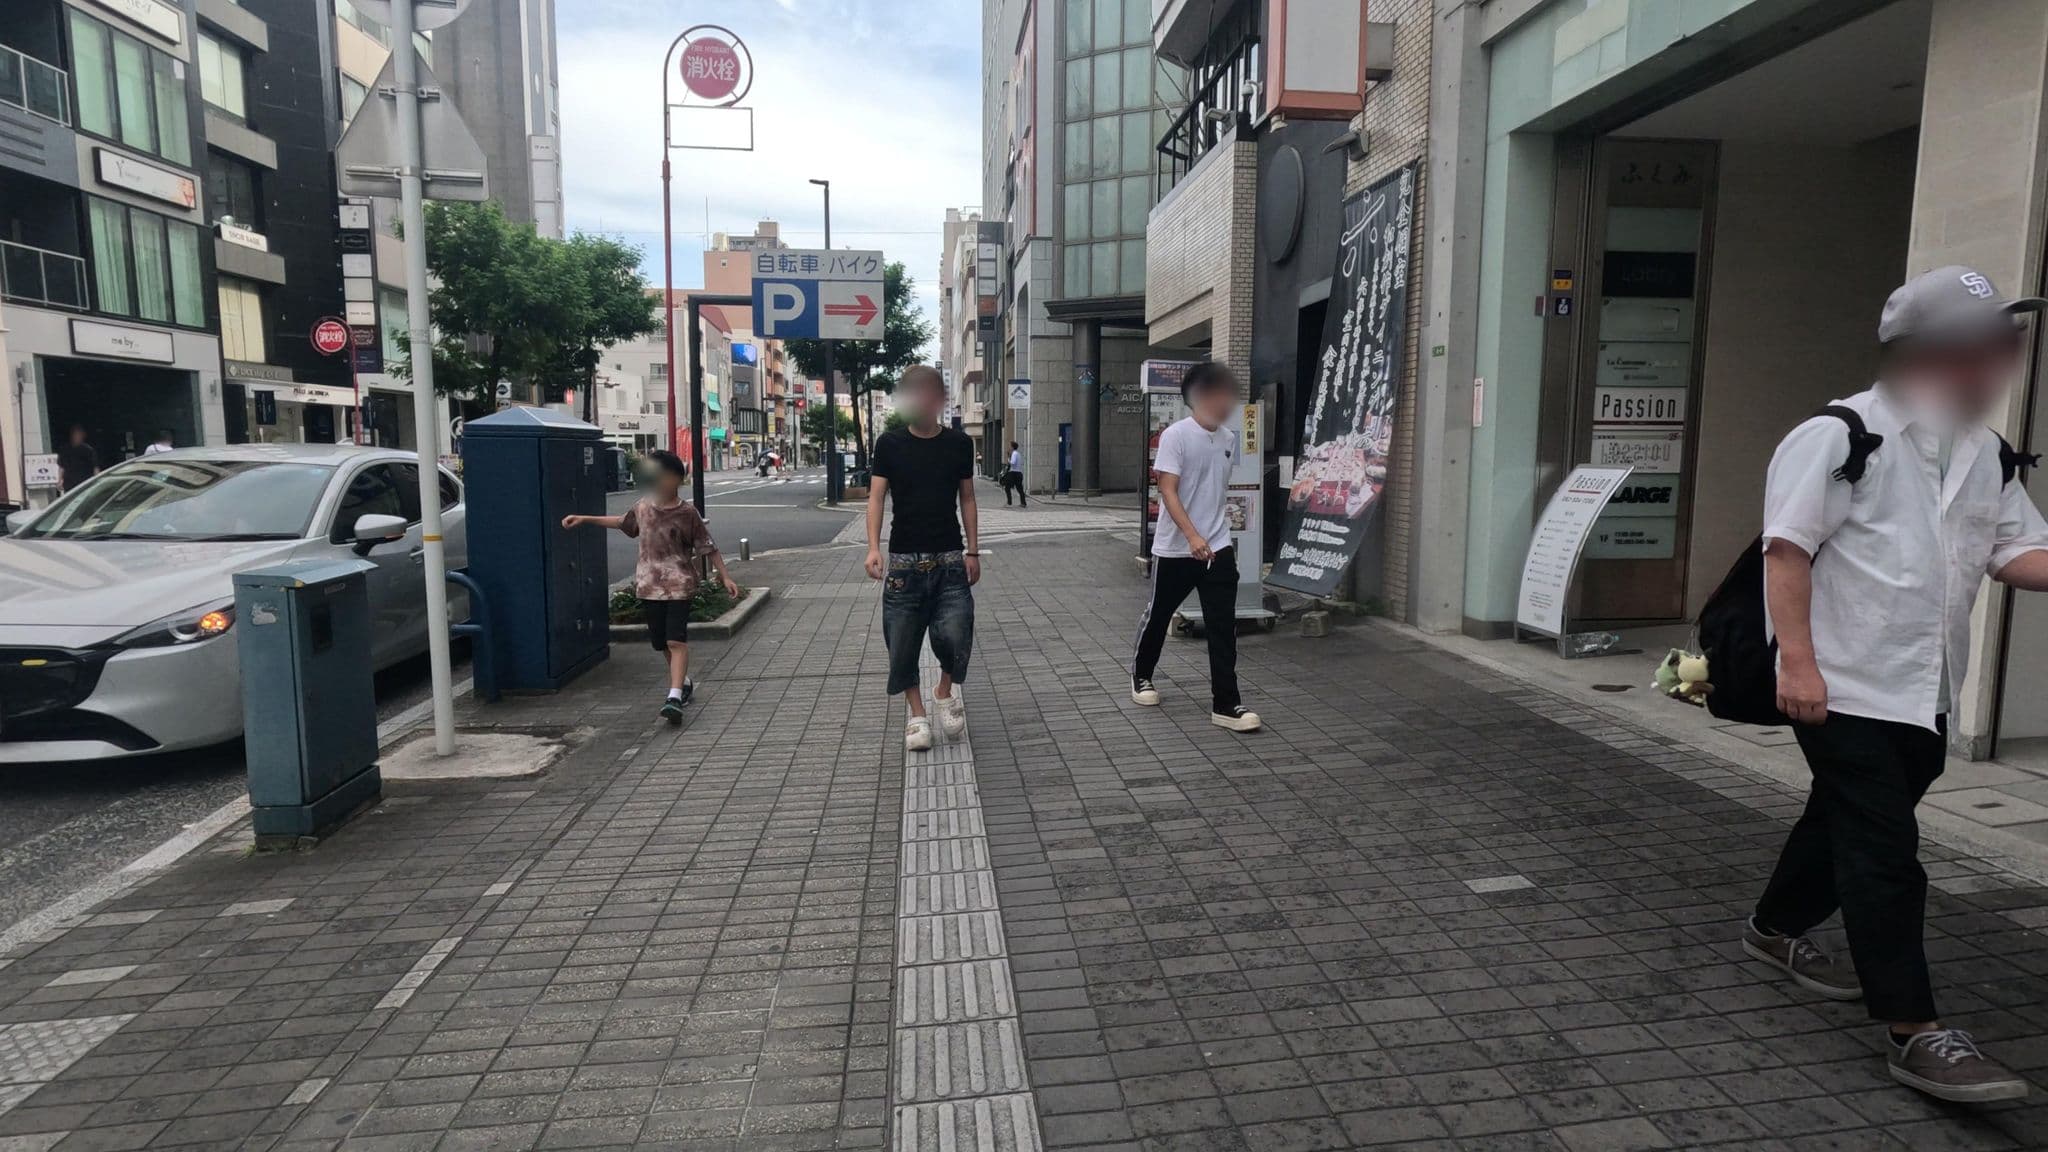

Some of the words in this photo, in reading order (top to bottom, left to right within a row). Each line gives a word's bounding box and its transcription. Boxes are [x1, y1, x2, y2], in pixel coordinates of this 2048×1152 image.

[687, 56, 736, 81] 消火栓
[757, 253, 878, 274] 自転車・バイク
[763, 283, 806, 335] P
[319, 331, 344, 343] 消火栓
[1602, 394, 1676, 418] Passion
[1246, 409, 1256, 450] 完全個室
